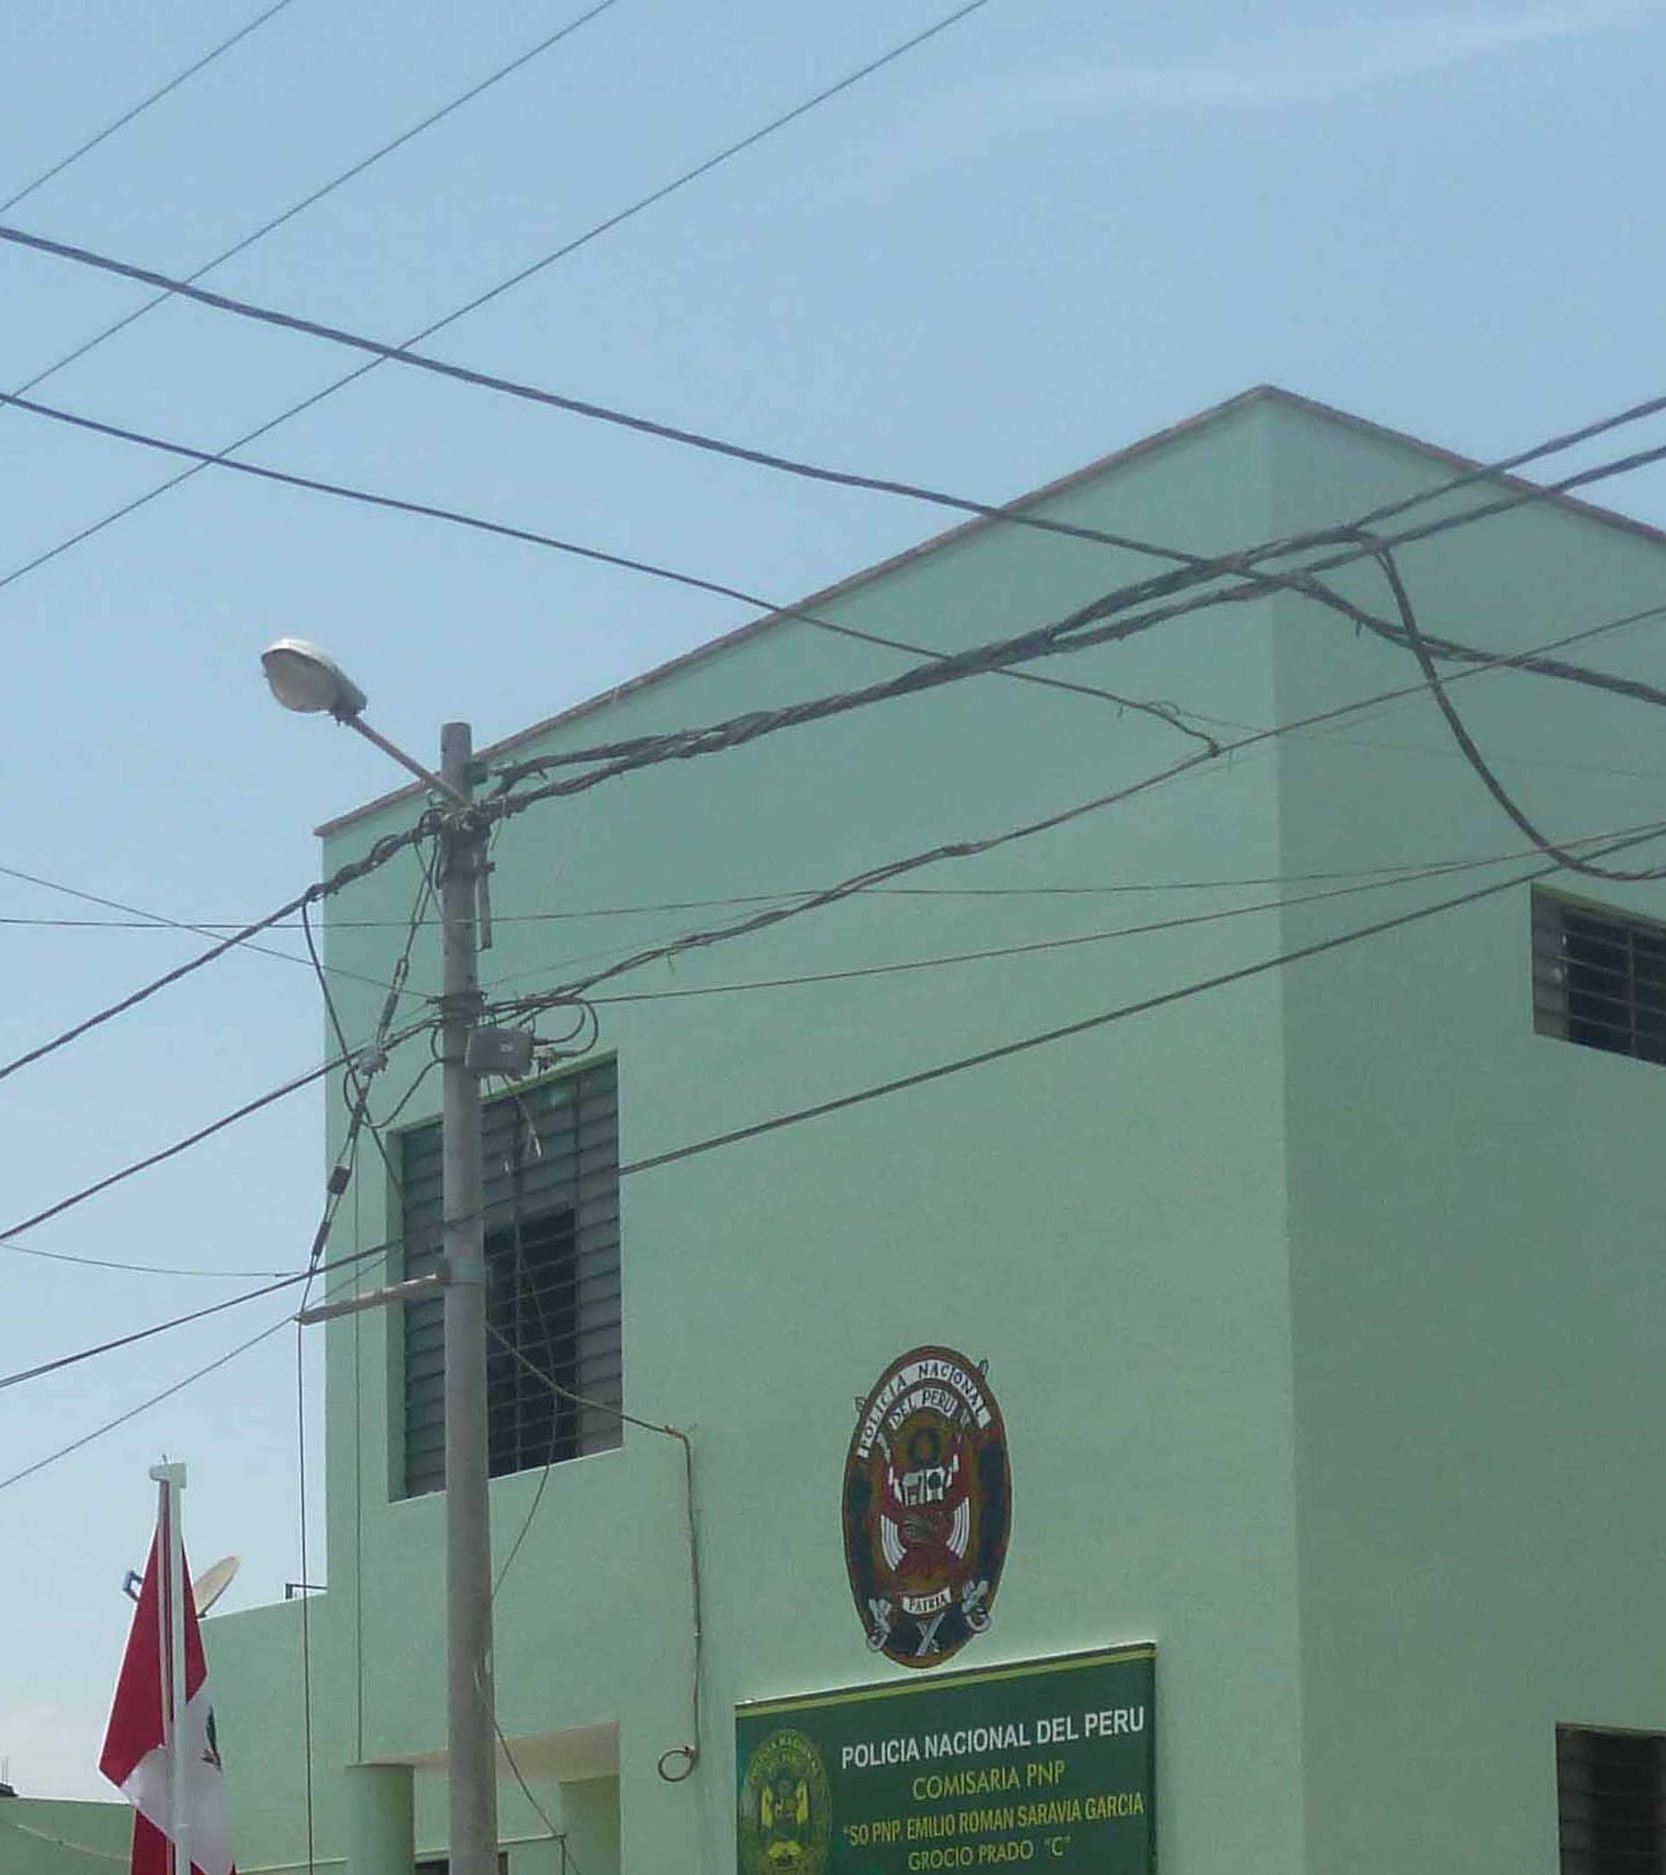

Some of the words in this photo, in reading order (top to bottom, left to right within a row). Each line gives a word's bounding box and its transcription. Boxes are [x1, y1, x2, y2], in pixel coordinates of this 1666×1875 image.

[918, 1361, 987, 1414] NACIONAL
[921, 1389, 958, 1414] PERU
[841, 1737, 920, 1769] POLICIA
[924, 1723, 1031, 1759] NACIONAL
[1036, 1716, 1079, 1745] DEL
[1084, 1706, 1144, 1738] PERU
[912, 1766, 1020, 1800] COMISARIA
[1026, 1760, 1066, 1787] PNP
[906, 1814, 956, 1840] EMILIO
[959, 1807, 1014, 1834] ROMAN
[1017, 1798, 1082, 1828] SARAVIA
[1084, 1791, 1144, 1820] GARCIA
[908, 1846, 974, 1871] GROCIO
[978, 1839, 1034, 1865] PRADO
